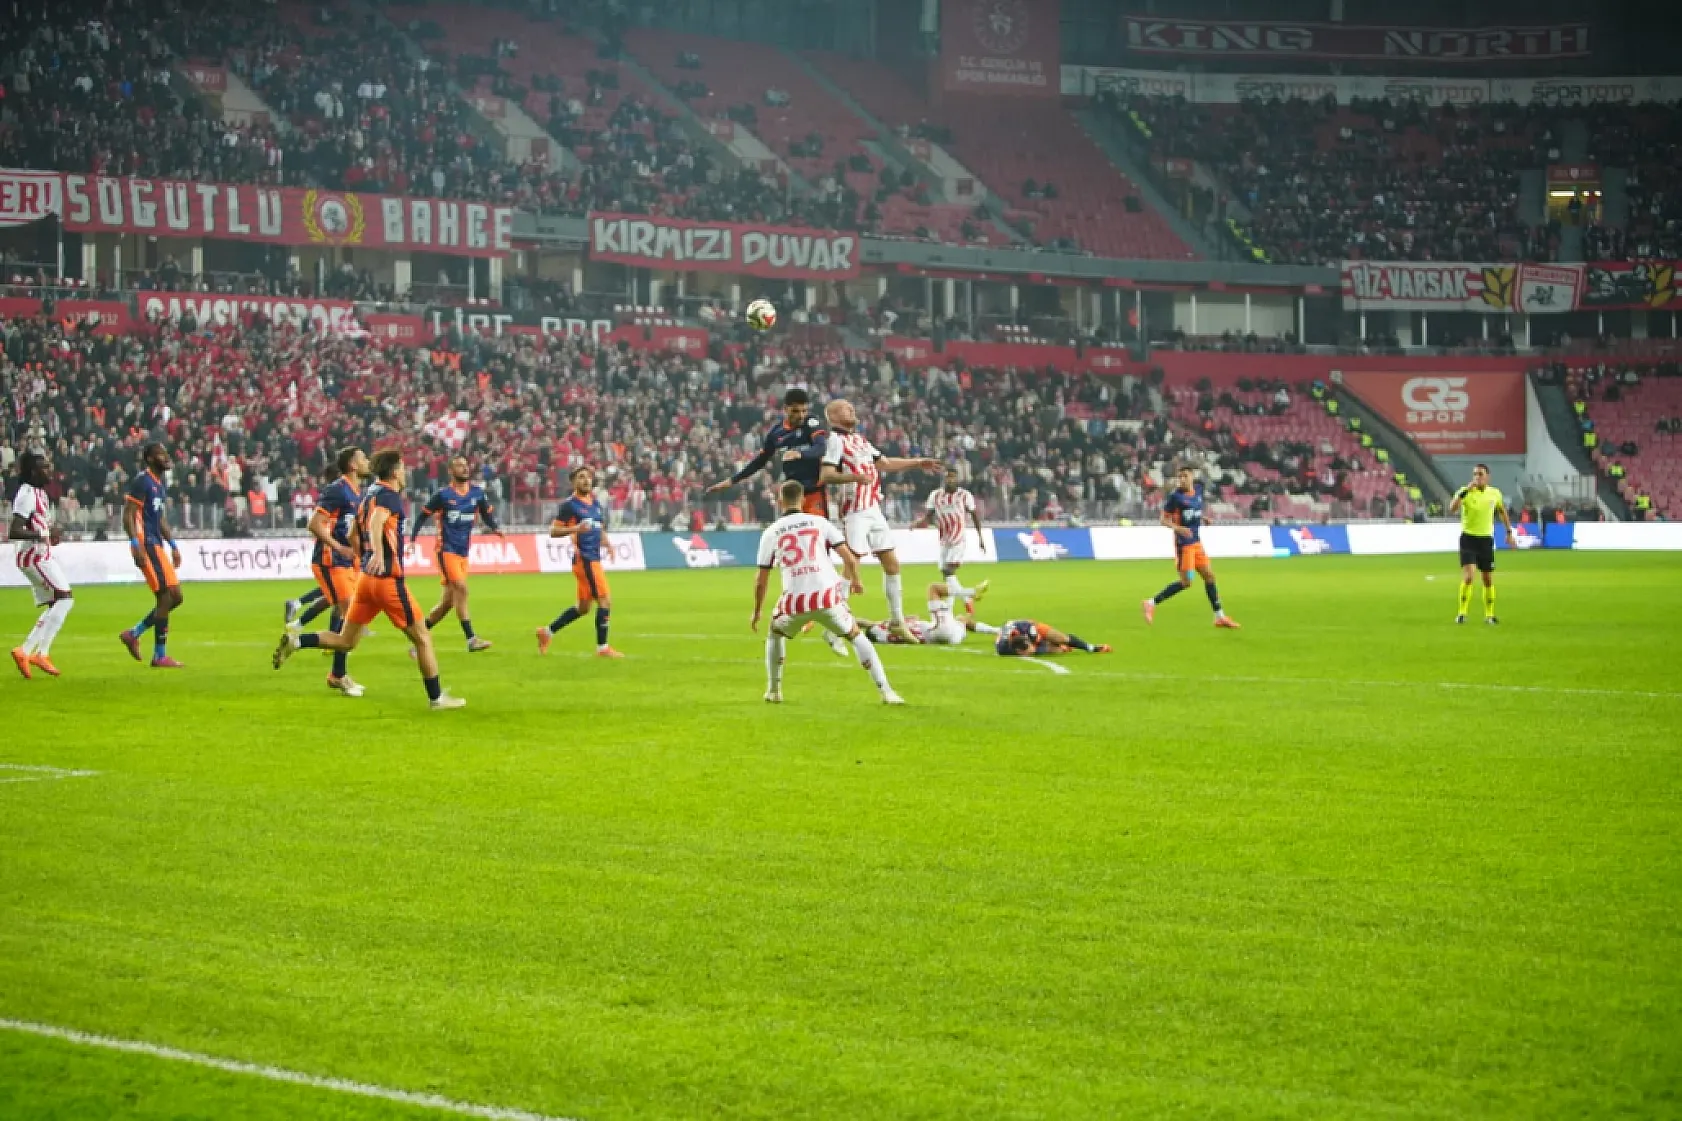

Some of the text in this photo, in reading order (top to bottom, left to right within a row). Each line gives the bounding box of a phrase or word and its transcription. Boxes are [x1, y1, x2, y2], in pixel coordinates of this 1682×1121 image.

[1127, 22, 1588, 55] KING NORTH
[594, 218, 854, 270] KIRMIZI DUVAR
[1406, 411, 1465, 424] SPOR
[778, 528, 819, 566] 37
